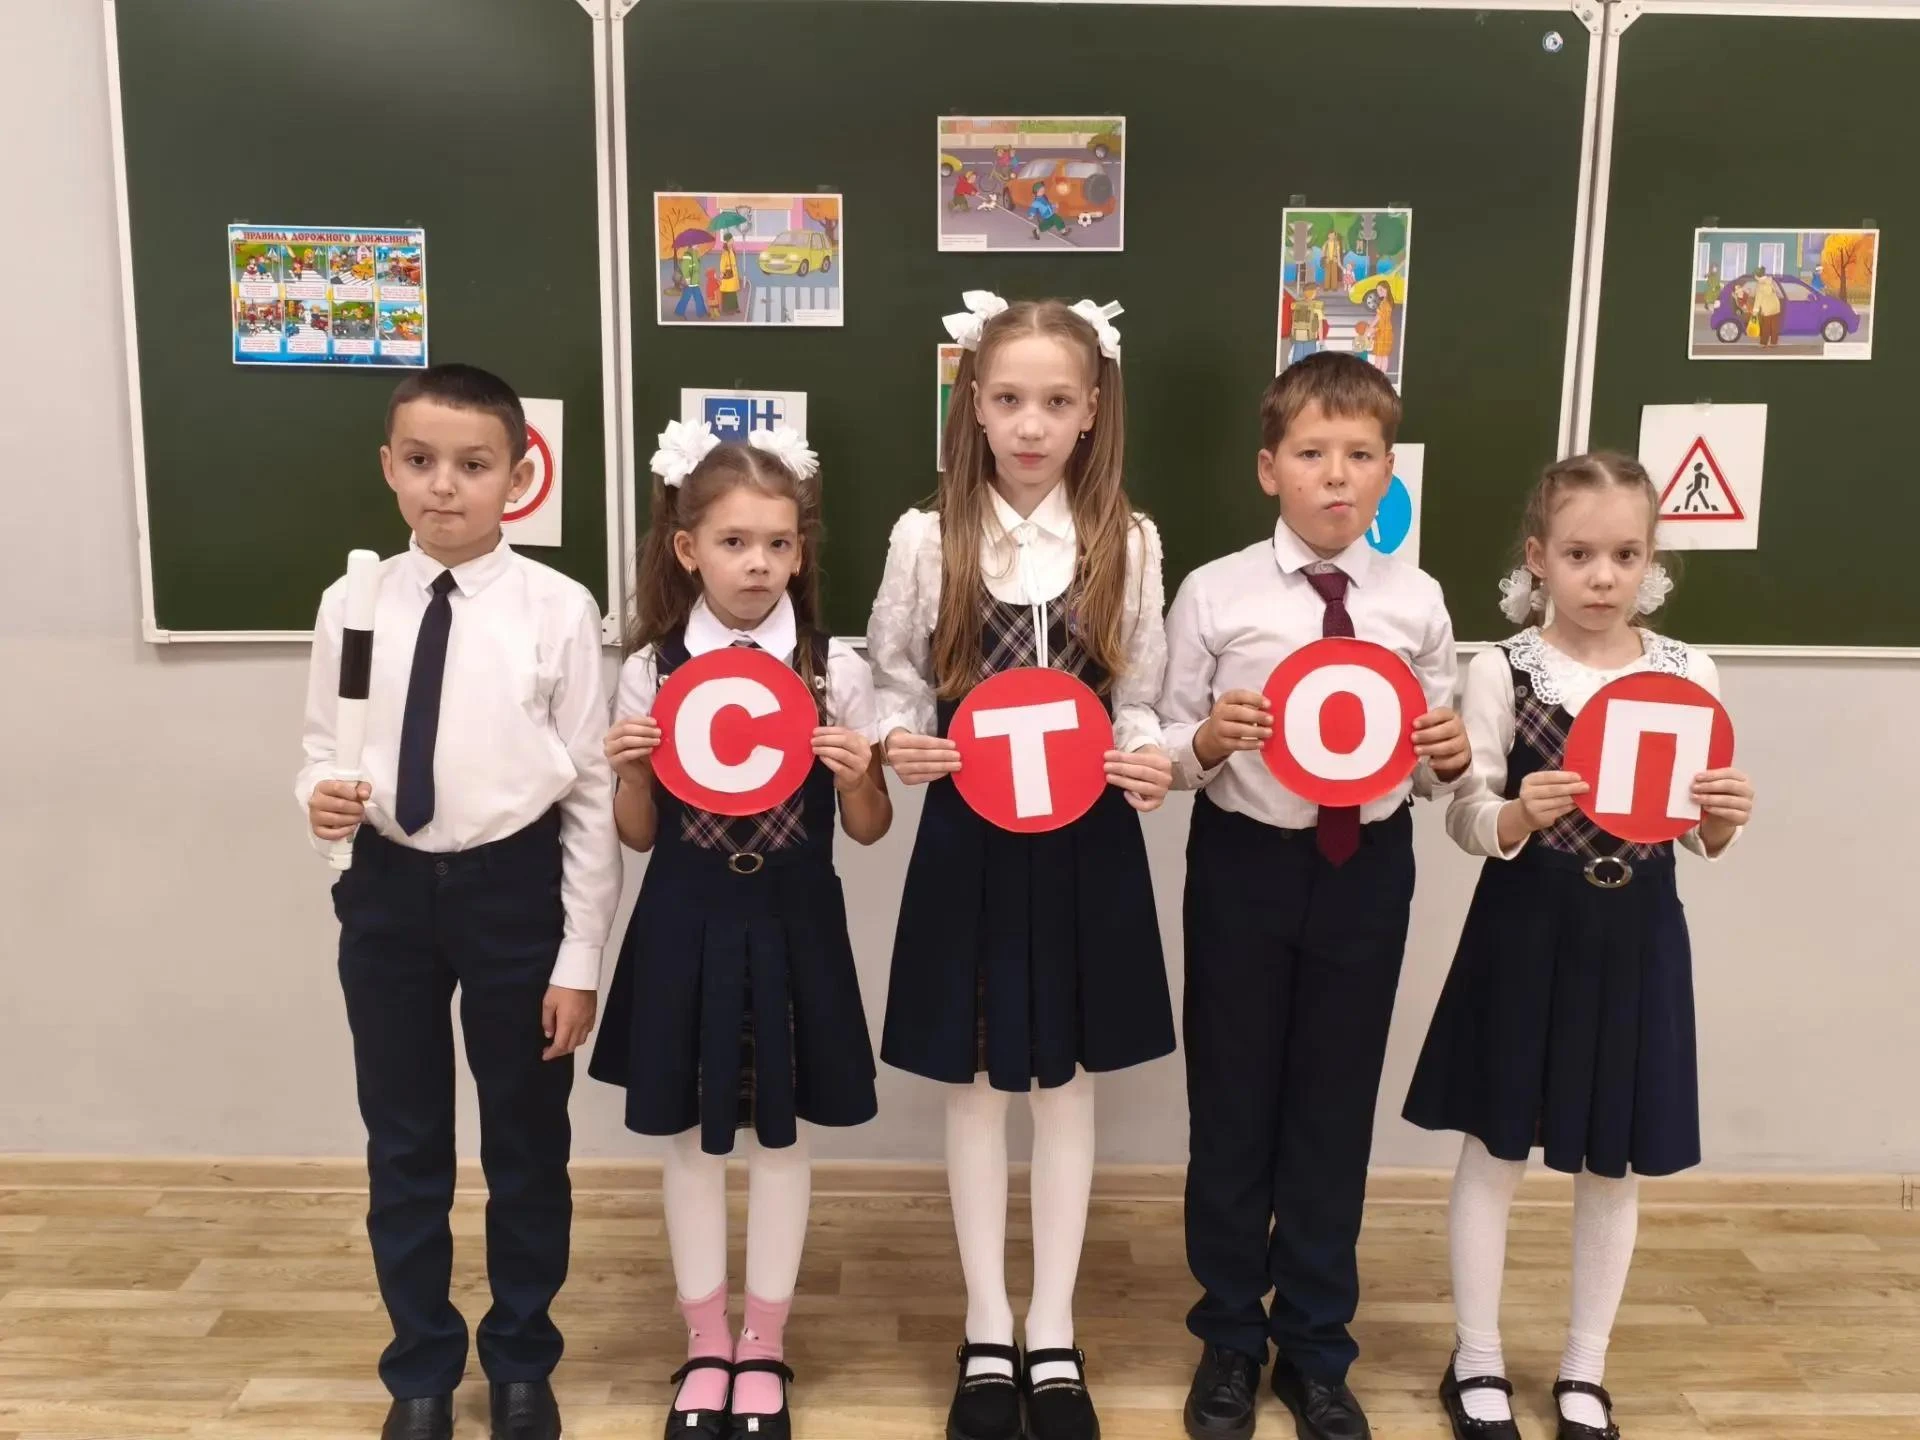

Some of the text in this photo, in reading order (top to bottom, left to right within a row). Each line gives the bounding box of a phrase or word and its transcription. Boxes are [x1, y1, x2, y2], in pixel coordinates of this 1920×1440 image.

[243, 231, 409, 245] ПРАВИЛА ДОРОЖНОГО ДВИЖЕНИЯ
